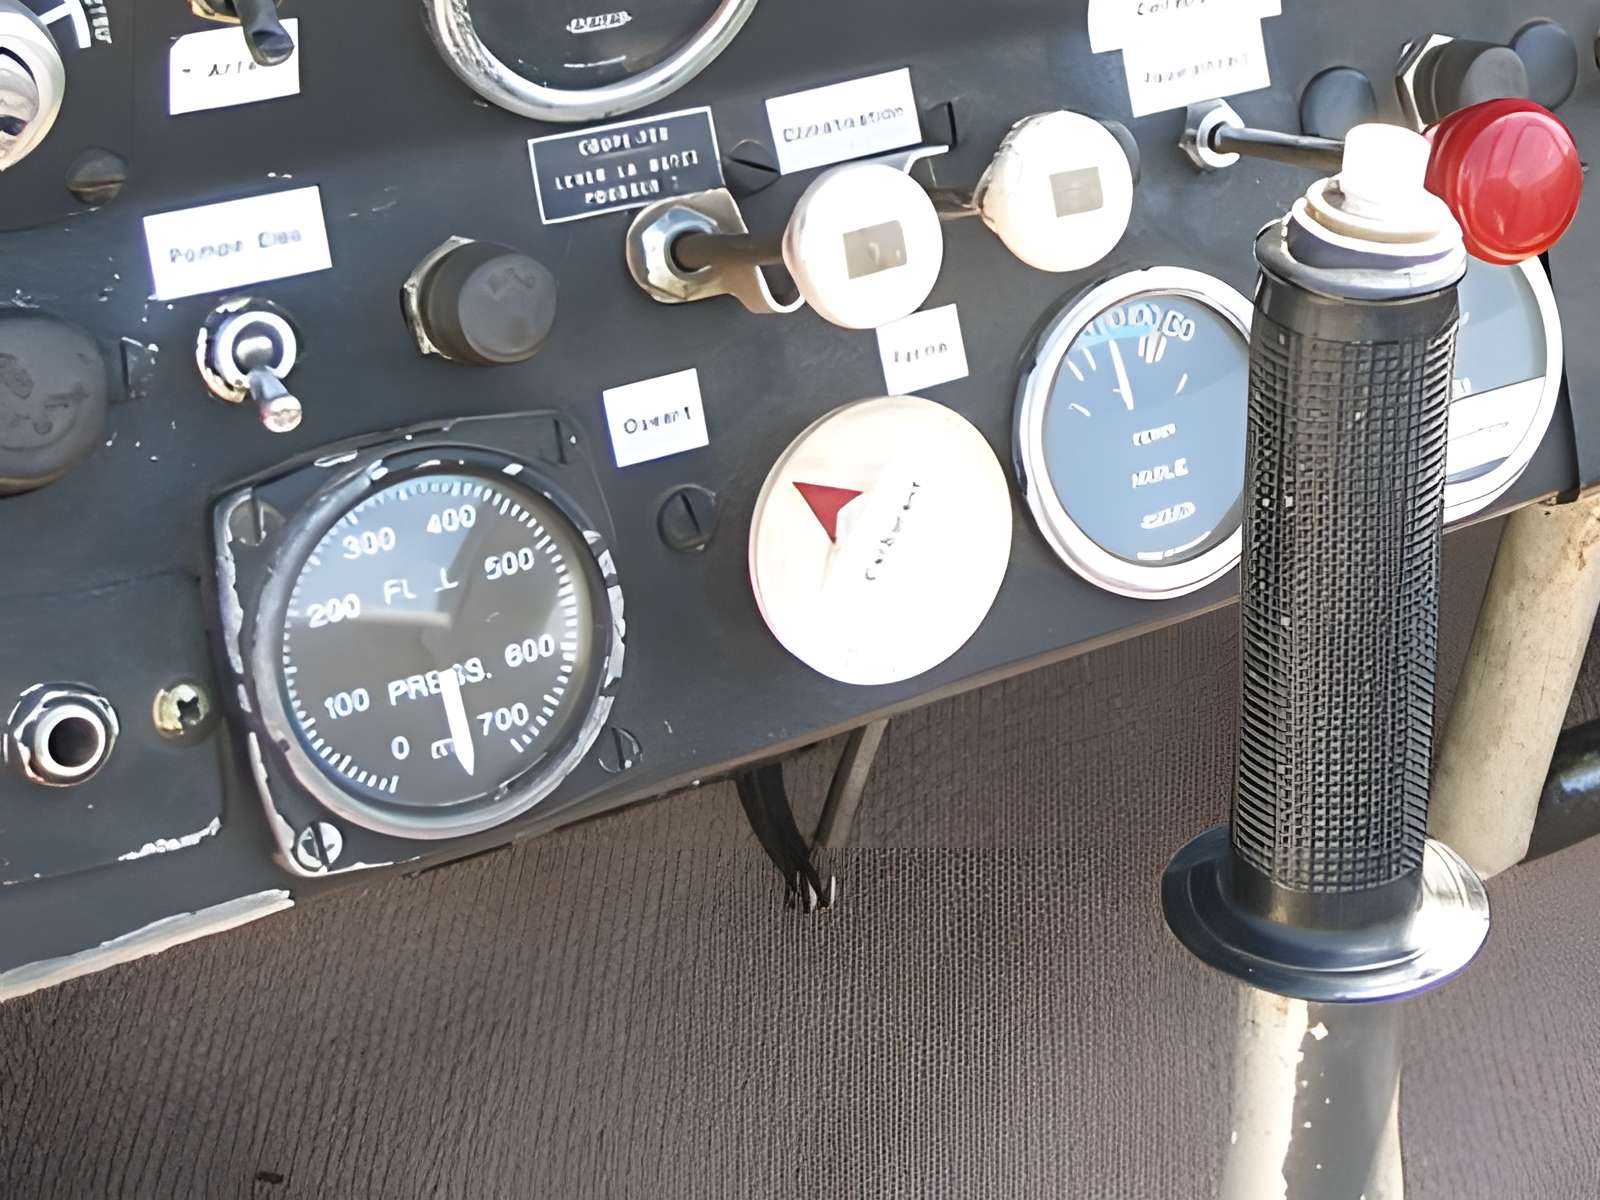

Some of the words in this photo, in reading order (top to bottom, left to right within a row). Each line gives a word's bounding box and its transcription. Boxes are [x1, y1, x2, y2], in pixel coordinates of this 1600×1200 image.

[426, 504, 477, 535] 400
[342, 527, 396, 559] 300
[484, 547, 536, 580] 500
[306, 594, 361, 628] 200
[504, 634, 556, 668] 600
[324, 687, 370, 720] 100
[476, 702, 530, 737] 700
[391, 736, 410, 761] 0
